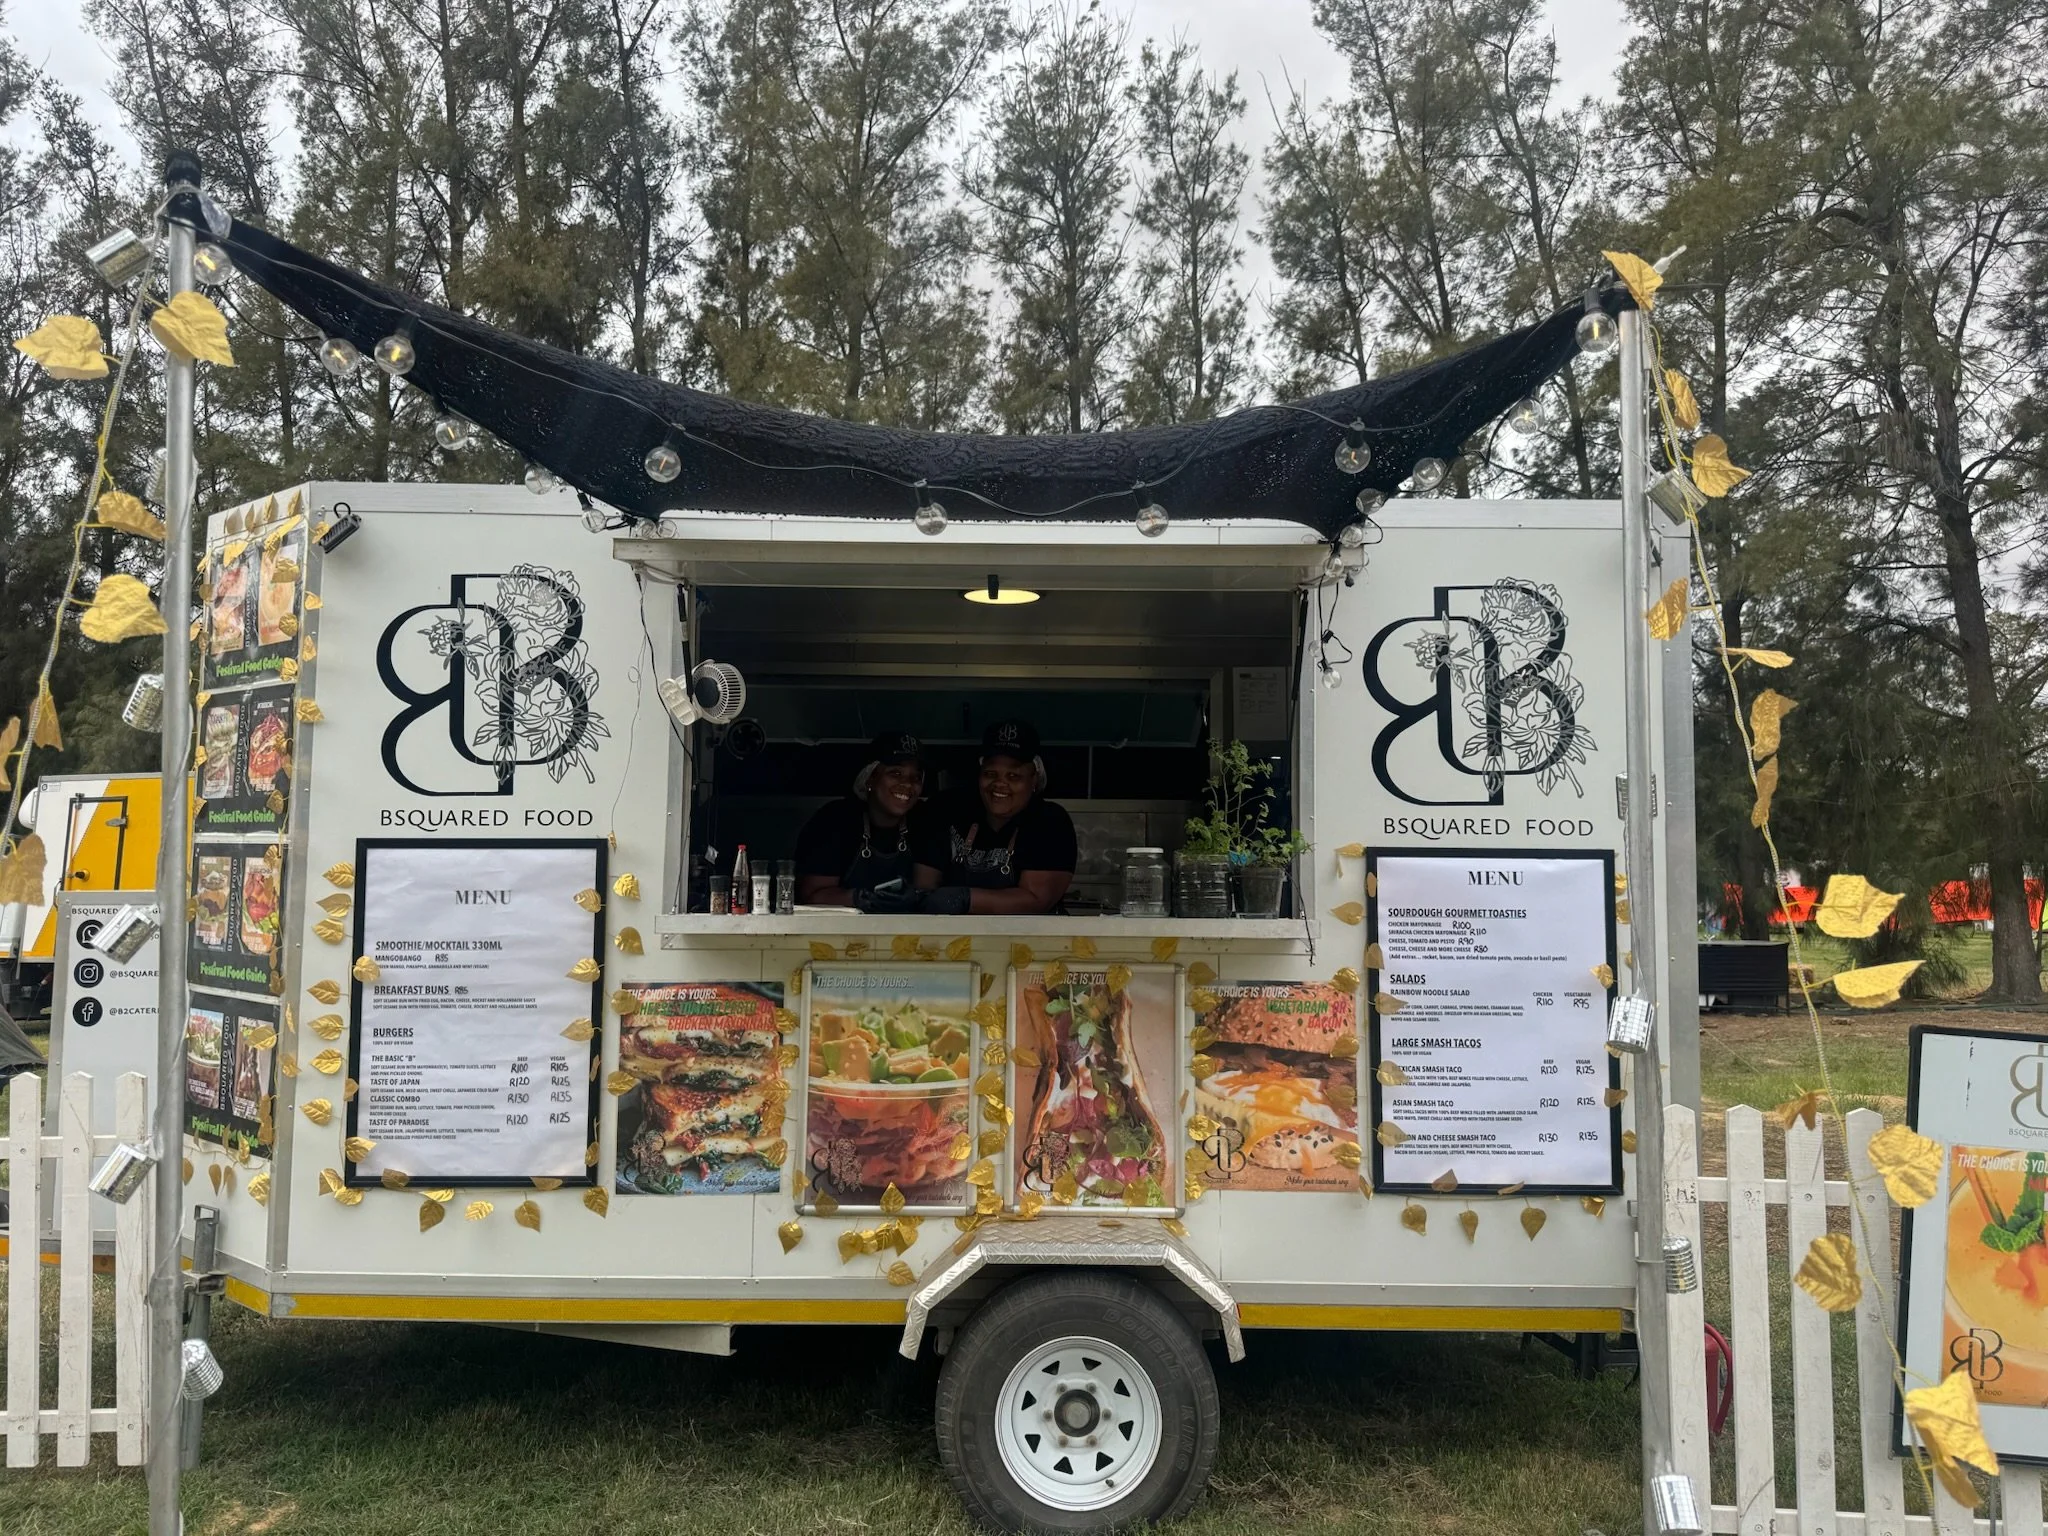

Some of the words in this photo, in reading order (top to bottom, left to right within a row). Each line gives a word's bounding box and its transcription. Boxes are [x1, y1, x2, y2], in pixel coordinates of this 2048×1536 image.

[381, 809, 509, 832] BSQUARED
[524, 809, 593, 826] FOOD
[1384, 817, 1511, 840] BSQUARED
[1526, 819, 1594, 836] FOOD
[1467, 871, 1525, 886] MENU
[455, 889, 512, 905] MENU
[1388, 908, 1443, 918] SOURDOUGH
[1445, 908, 1487, 919] GOURMET
[1488, 909, 1527, 919] TOASTIES
[1452, 920, 1472, 930] R100
[1469, 928, 1487, 936] R110
[375, 940, 470, 951] SMOOTHIE/MOCKTAIL
[471, 940, 503, 951] 330ML
[1457, 937, 1474, 946] R90
[374, 954, 422, 962] MANGOBANGO
[816, 974, 833, 988] THE
[833, 975, 867, 988] CHOICE
[867, 975, 877, 988] IS
[1028, 972, 1045, 985] THE
[1080, 972, 1090, 985] IS
[1390, 974, 1426, 984] SALADS
[373, 985, 424, 995] BREAKFAST
[425, 985, 450, 995] BUNS
[644, 988, 677, 1001] CHOICE
[677, 988, 687, 1000] IS
[1218, 986, 1249, 998] CHOICE
[1250, 986, 1260, 998] IS
[1449, 989, 1470, 997] SALAD
[1536, 998, 1554, 1007] R110
[1573, 998, 1590, 1010] R95
[1307, 1015, 1343, 1029] BACON
[373, 1027, 414, 1038] BURGERS
[1392, 1038, 1419, 1048] LARGE
[1421, 1038, 1452, 1048] SMASH
[1454, 1039, 1482, 1049] TACOS
[510, 1063, 529, 1074] R100
[550, 1062, 569, 1072] R105
[1422, 1065, 1445, 1074] SMASH
[1444, 1066, 1463, 1074] TACO
[1540, 1065, 1559, 1075] R120
[1575, 1065, 1595, 1075] R125
[370, 1078, 389, 1086] TASTE
[389, 1078, 398, 1086] OF
[399, 1078, 420, 1086] JAPAN
[509, 1076, 530, 1087] R120
[551, 1076, 571, 1087] R125
[370, 1095, 395, 1103] CLASSIC
[396, 1095, 421, 1103] COMBO
[507, 1093, 530, 1104] R130
[550, 1091, 572, 1103] R135
[1392, 1099, 1413, 1107] ASIAN
[1413, 1099, 1437, 1107] SMASH
[1540, 1097, 1560, 1108] R120
[1576, 1097, 1596, 1106] R125
[506, 1114, 529, 1126] R120
[549, 1111, 571, 1124] R125
[1432, 1134, 1457, 1142] CHEESE
[1456, 1134, 1480, 1142] SMASH
[1479, 1134, 1497, 1142] TACO
[1538, 1133, 1559, 1143] R130
[1579, 1131, 1598, 1141] R135
[1957, 1153, 1977, 1168] THE
[1979, 1155, 2017, 1171] CHOICE
[2017, 1158, 2030, 1172] IS
